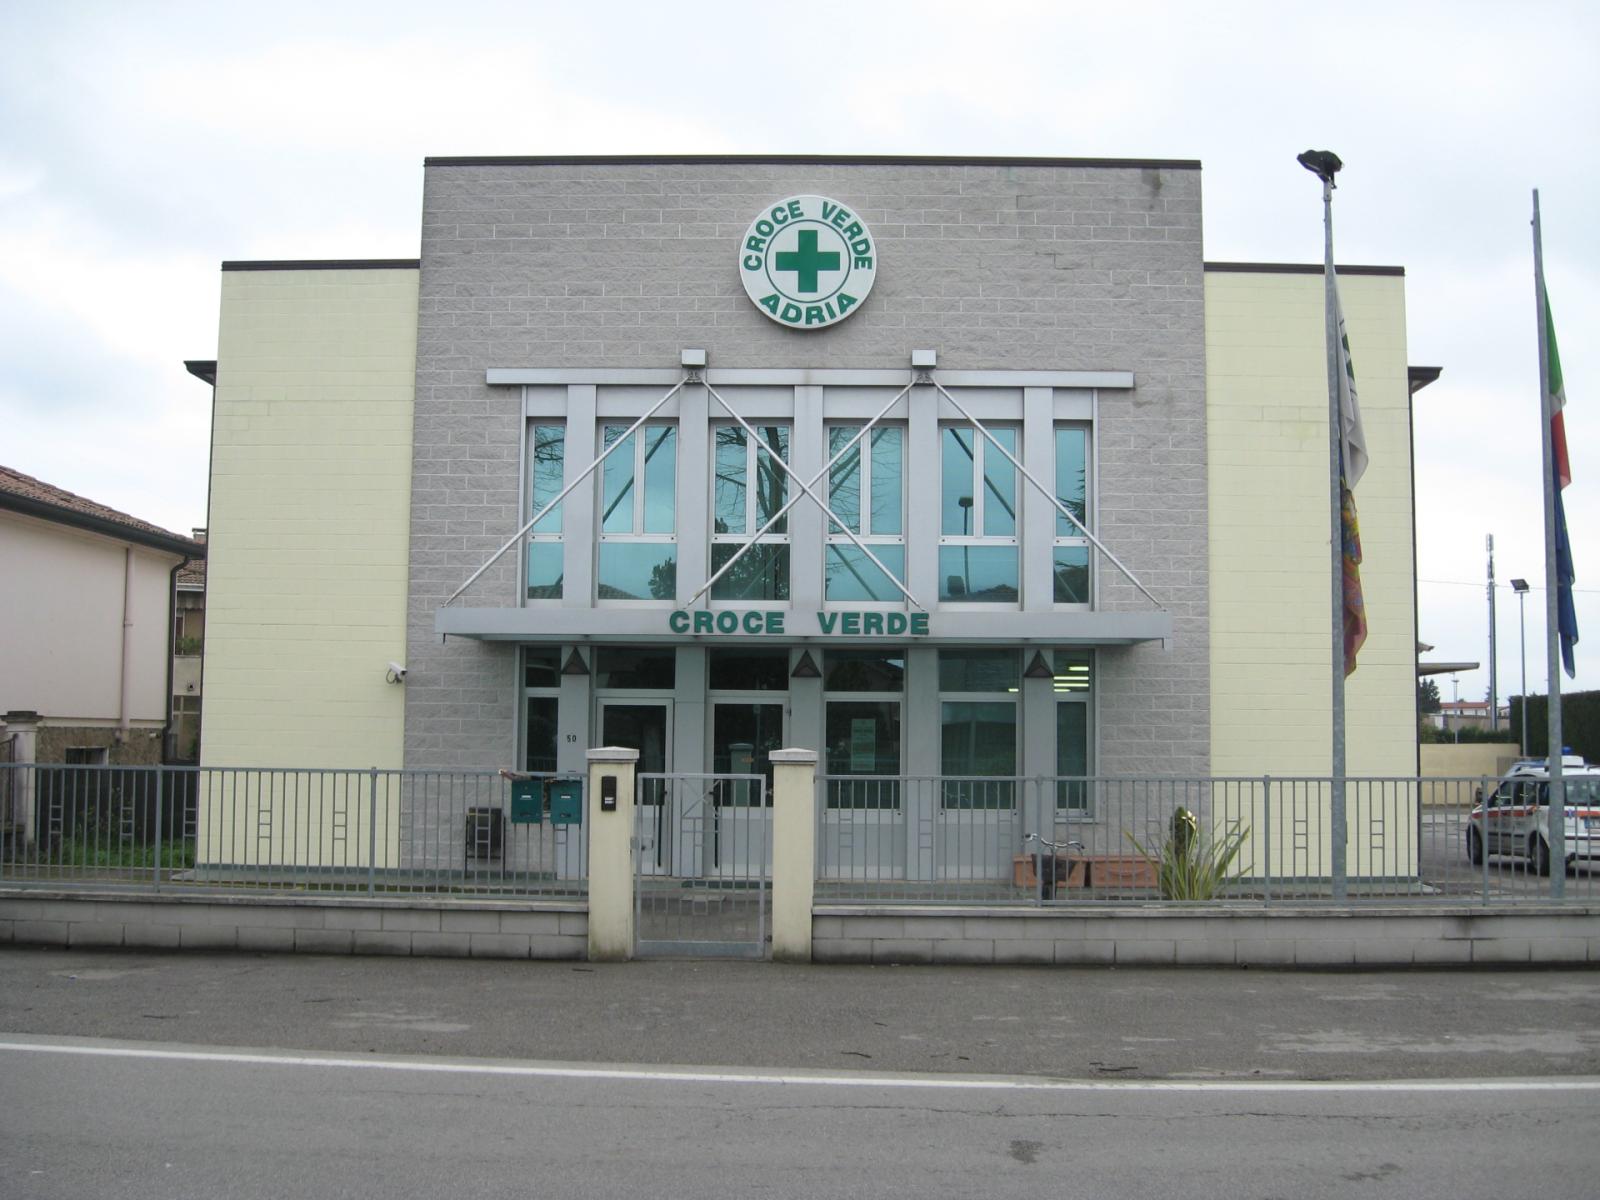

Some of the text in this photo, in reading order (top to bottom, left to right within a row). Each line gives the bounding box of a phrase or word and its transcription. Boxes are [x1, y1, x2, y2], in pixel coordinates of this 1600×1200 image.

[743, 200, 873, 271] CROCE VERDE
[759, 292, 858, 325] ADRIA
[669, 610, 930, 635] CROCE VERDE
